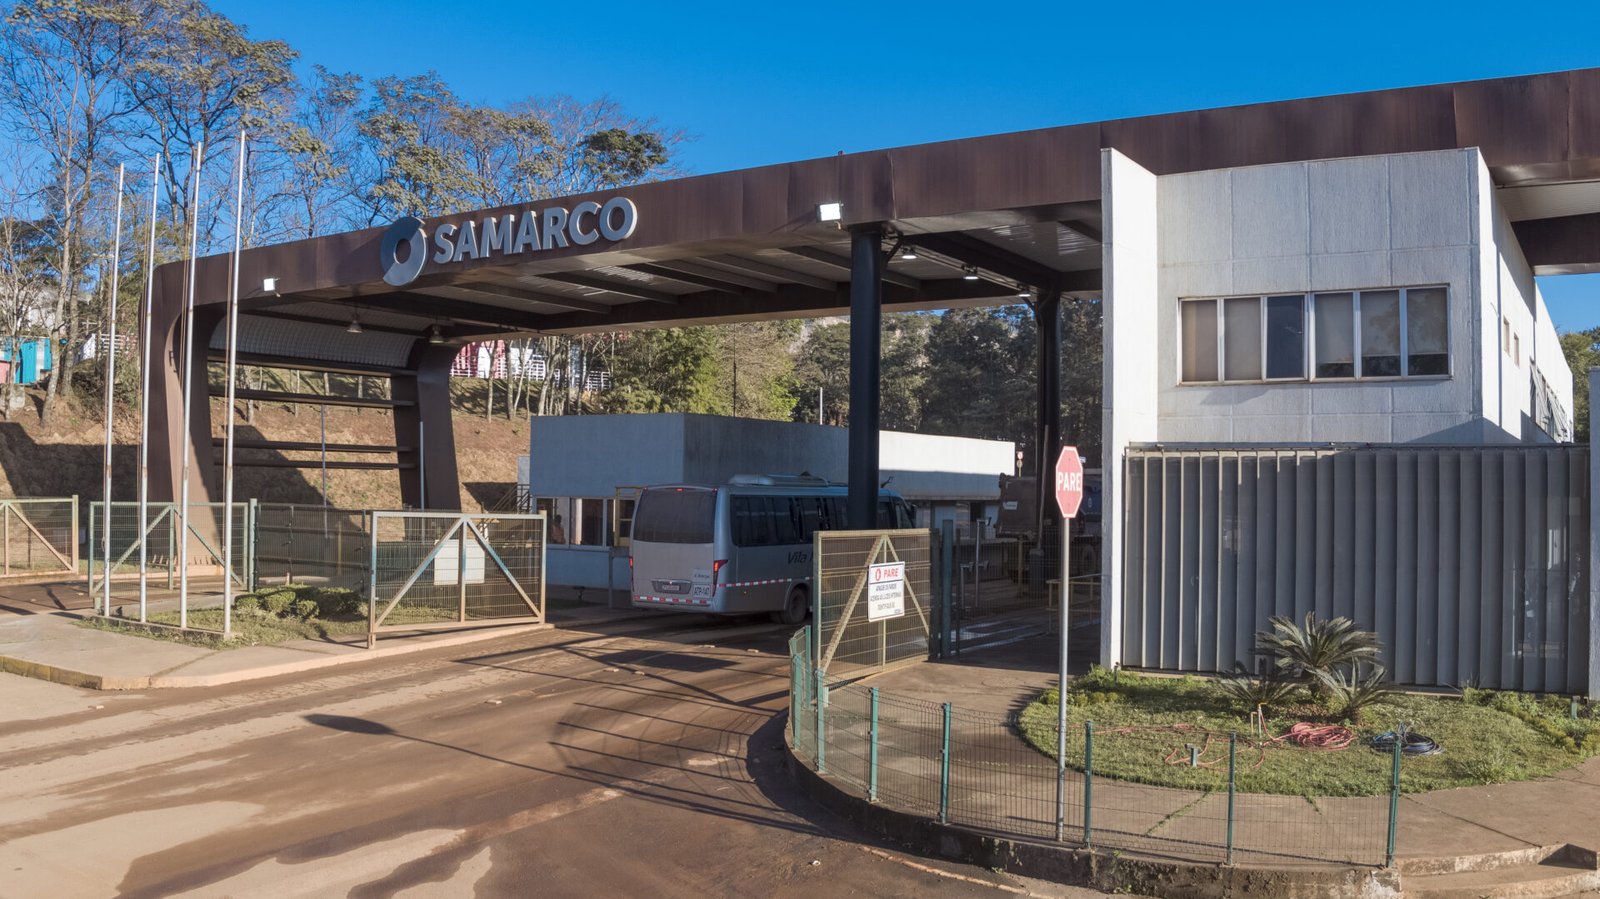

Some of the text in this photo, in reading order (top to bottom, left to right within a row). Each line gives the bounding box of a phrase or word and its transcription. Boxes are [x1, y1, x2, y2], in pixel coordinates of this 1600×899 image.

[432, 196, 638, 265] SAMARCO
[1057, 471, 1081, 492] PARE
[787, 551, 808, 564] Vila
[883, 567, 899, 579] PARE
